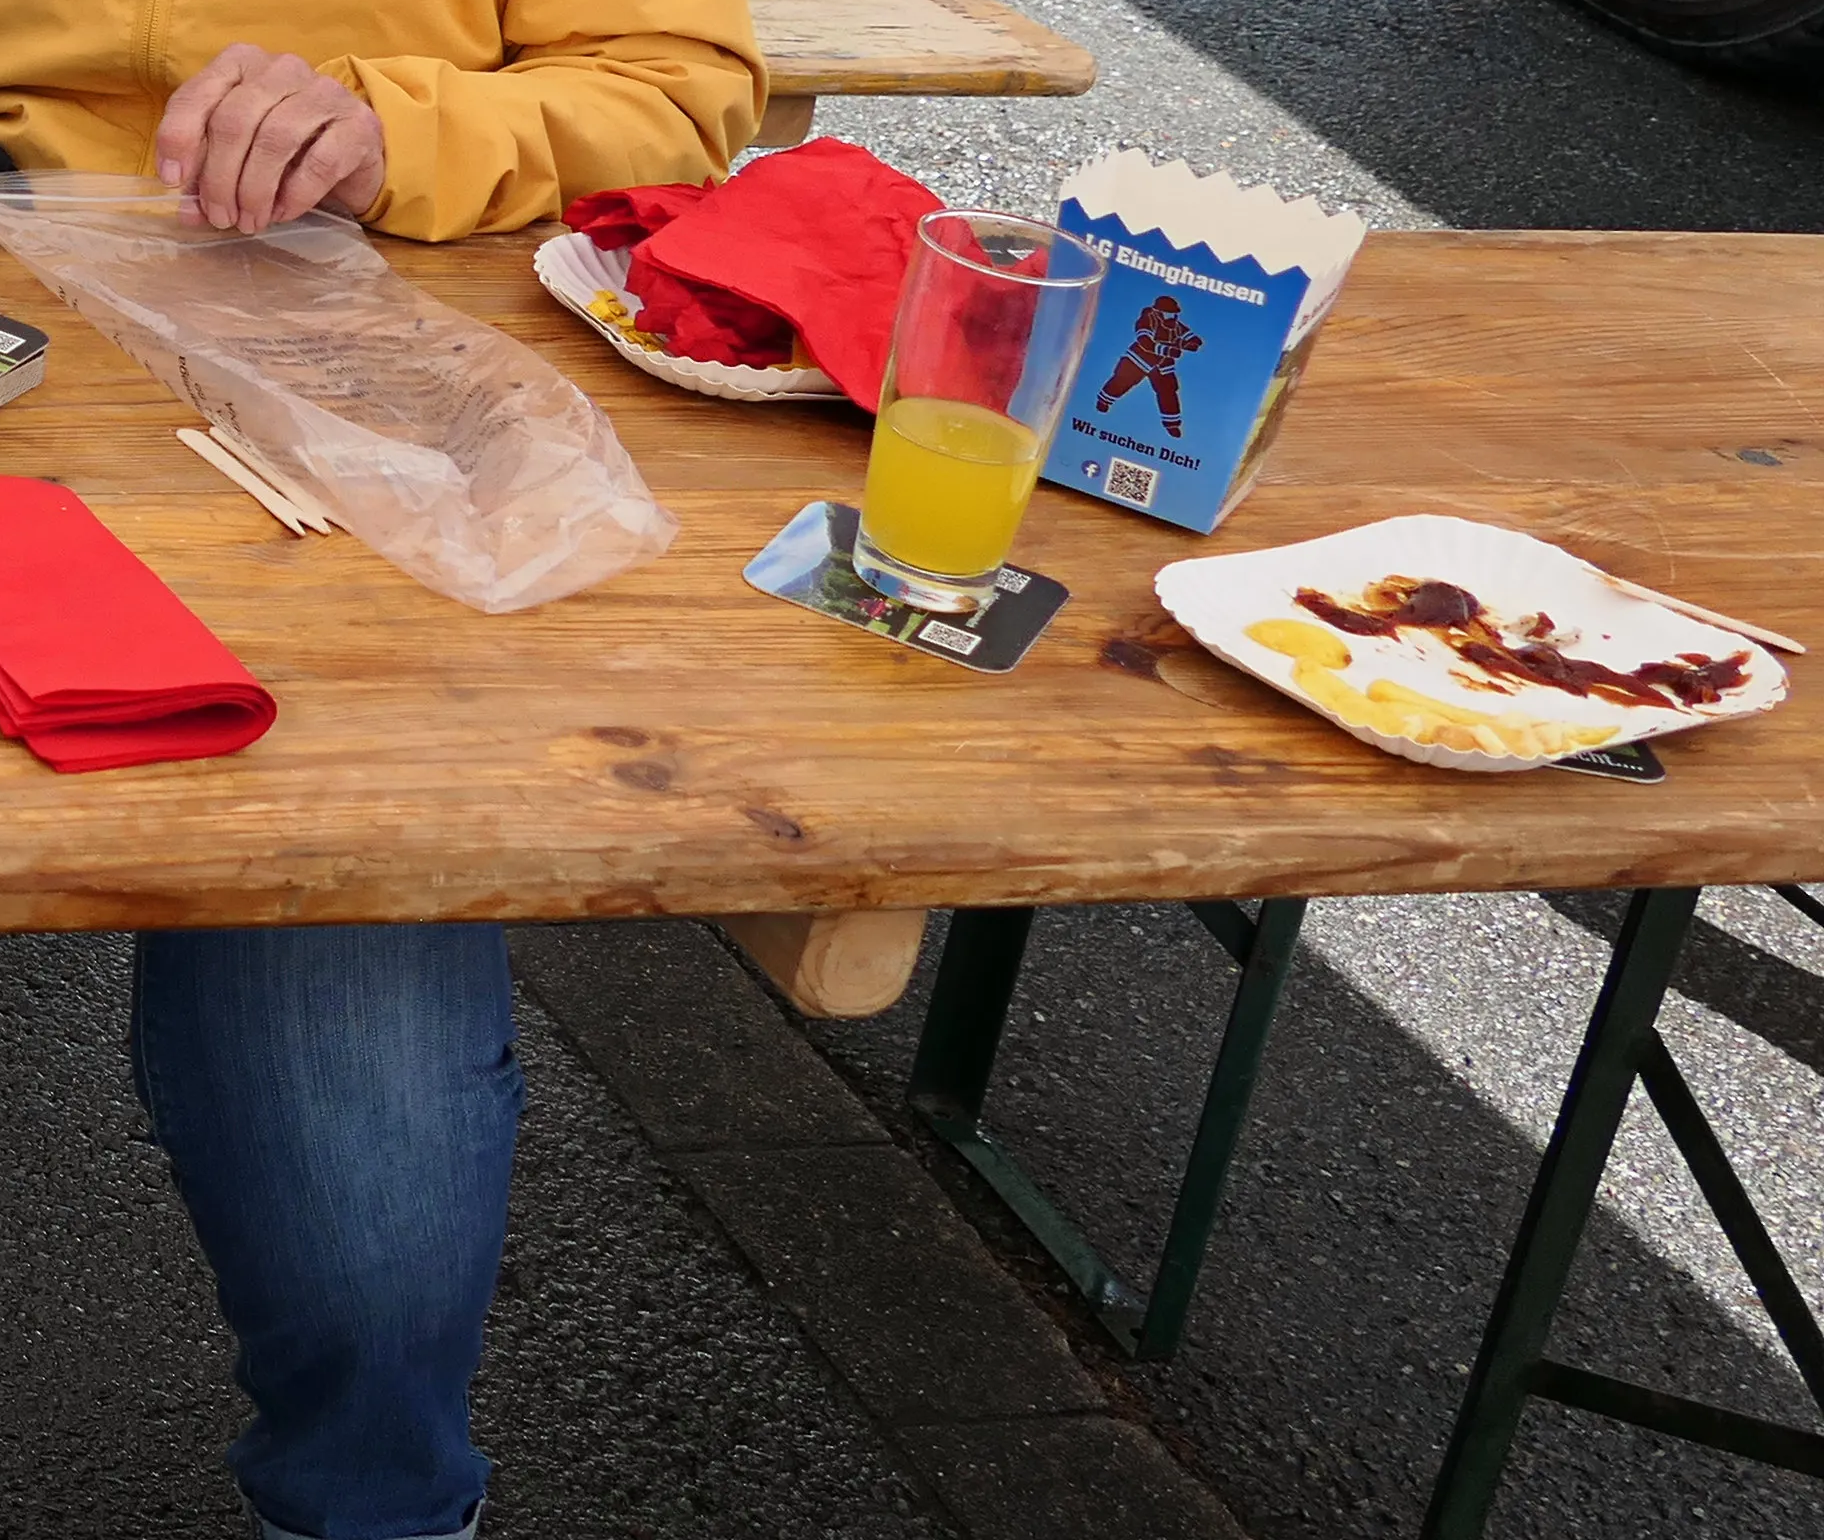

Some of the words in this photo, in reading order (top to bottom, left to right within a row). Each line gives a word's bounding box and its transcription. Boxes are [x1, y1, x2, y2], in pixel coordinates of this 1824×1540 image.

[1114, 243, 1266, 307] Eiringhausen
[1071, 415, 1098, 438] Wir
[1098, 429, 1156, 457] suchen
[1158, 445, 1203, 472] Dich!
